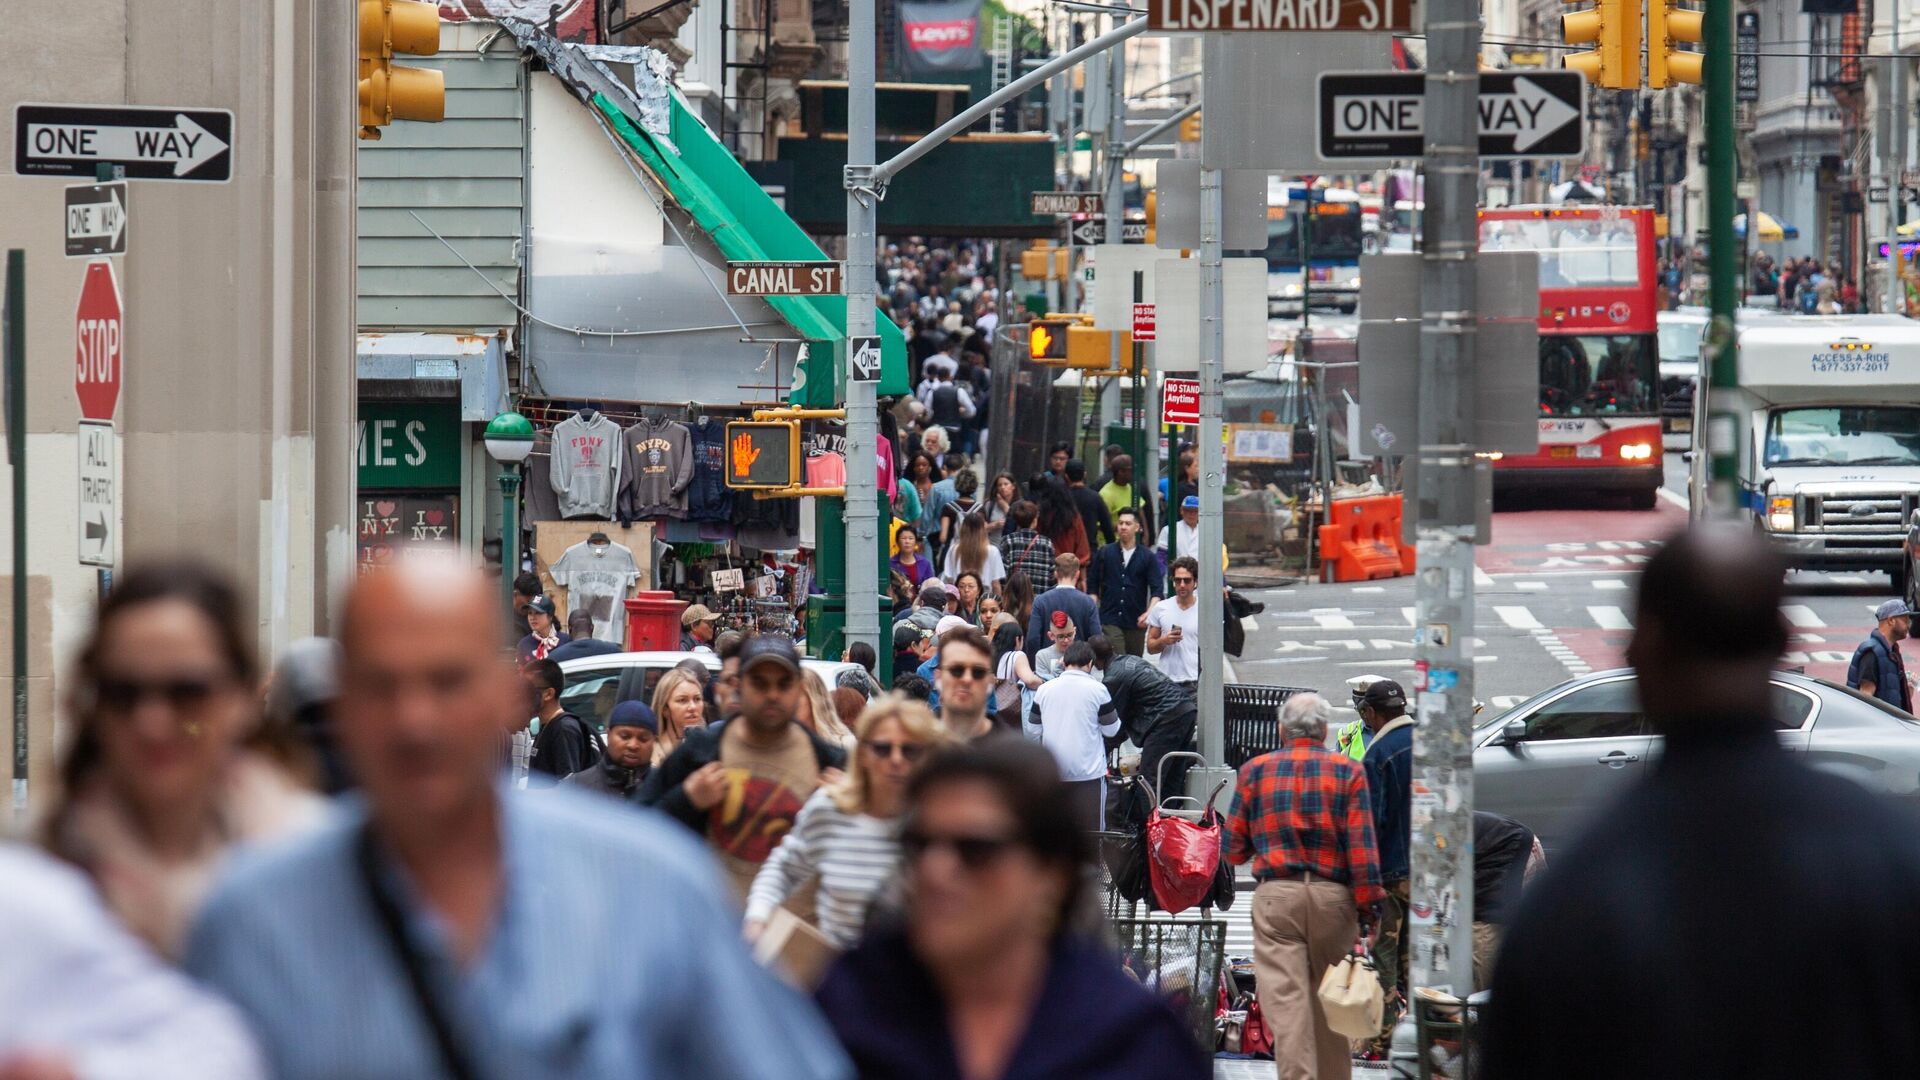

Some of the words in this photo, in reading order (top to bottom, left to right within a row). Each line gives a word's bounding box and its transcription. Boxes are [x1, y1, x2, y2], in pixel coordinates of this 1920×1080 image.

[1161, 0, 1340, 30] LISPENARD
[1358, 0, 1394, 30] ST
[1343, 100, 1420, 132] ONE
[1478, 98, 1547, 131] WAY
[35, 127, 98, 155] ONE
[135, 131, 203, 159] WAY
[1034, 195, 1080, 212] HOWARD
[1084, 196, 1099, 212] ST
[70, 207, 91, 234] ONE
[101, 205, 120, 233] WAY
[1082, 226, 1106, 239] ONE
[1121, 224, 1147, 237] WAY
[733, 267, 801, 294] CANAL
[809, 267, 835, 293] ST
[1134, 307, 1143, 315] NO
[1143, 307, 1155, 315] STA
[1135, 316, 1155, 324] Anytim
[77, 318, 119, 384] STOP
[860, 350, 879, 368] ONE
[1812, 352, 1889, 363] ACCESS-A-RIDE
[1812, 362, 1889, 372] 1-877-337-2017
[1167, 383, 1178, 393] NO
[1178, 384, 1200, 394] STAND
[1167, 393, 1196, 405] Anytime
[87, 430, 107, 467] ALL
[571, 436, 604, 448] FDNY
[635, 438, 673, 454] NYPD
[82, 476, 112, 505] TRAFFIC
[364, 501, 375, 517] I
[361, 517, 399, 535] NY
[416, 510, 426, 526] I
[410, 526, 448, 541] NY
